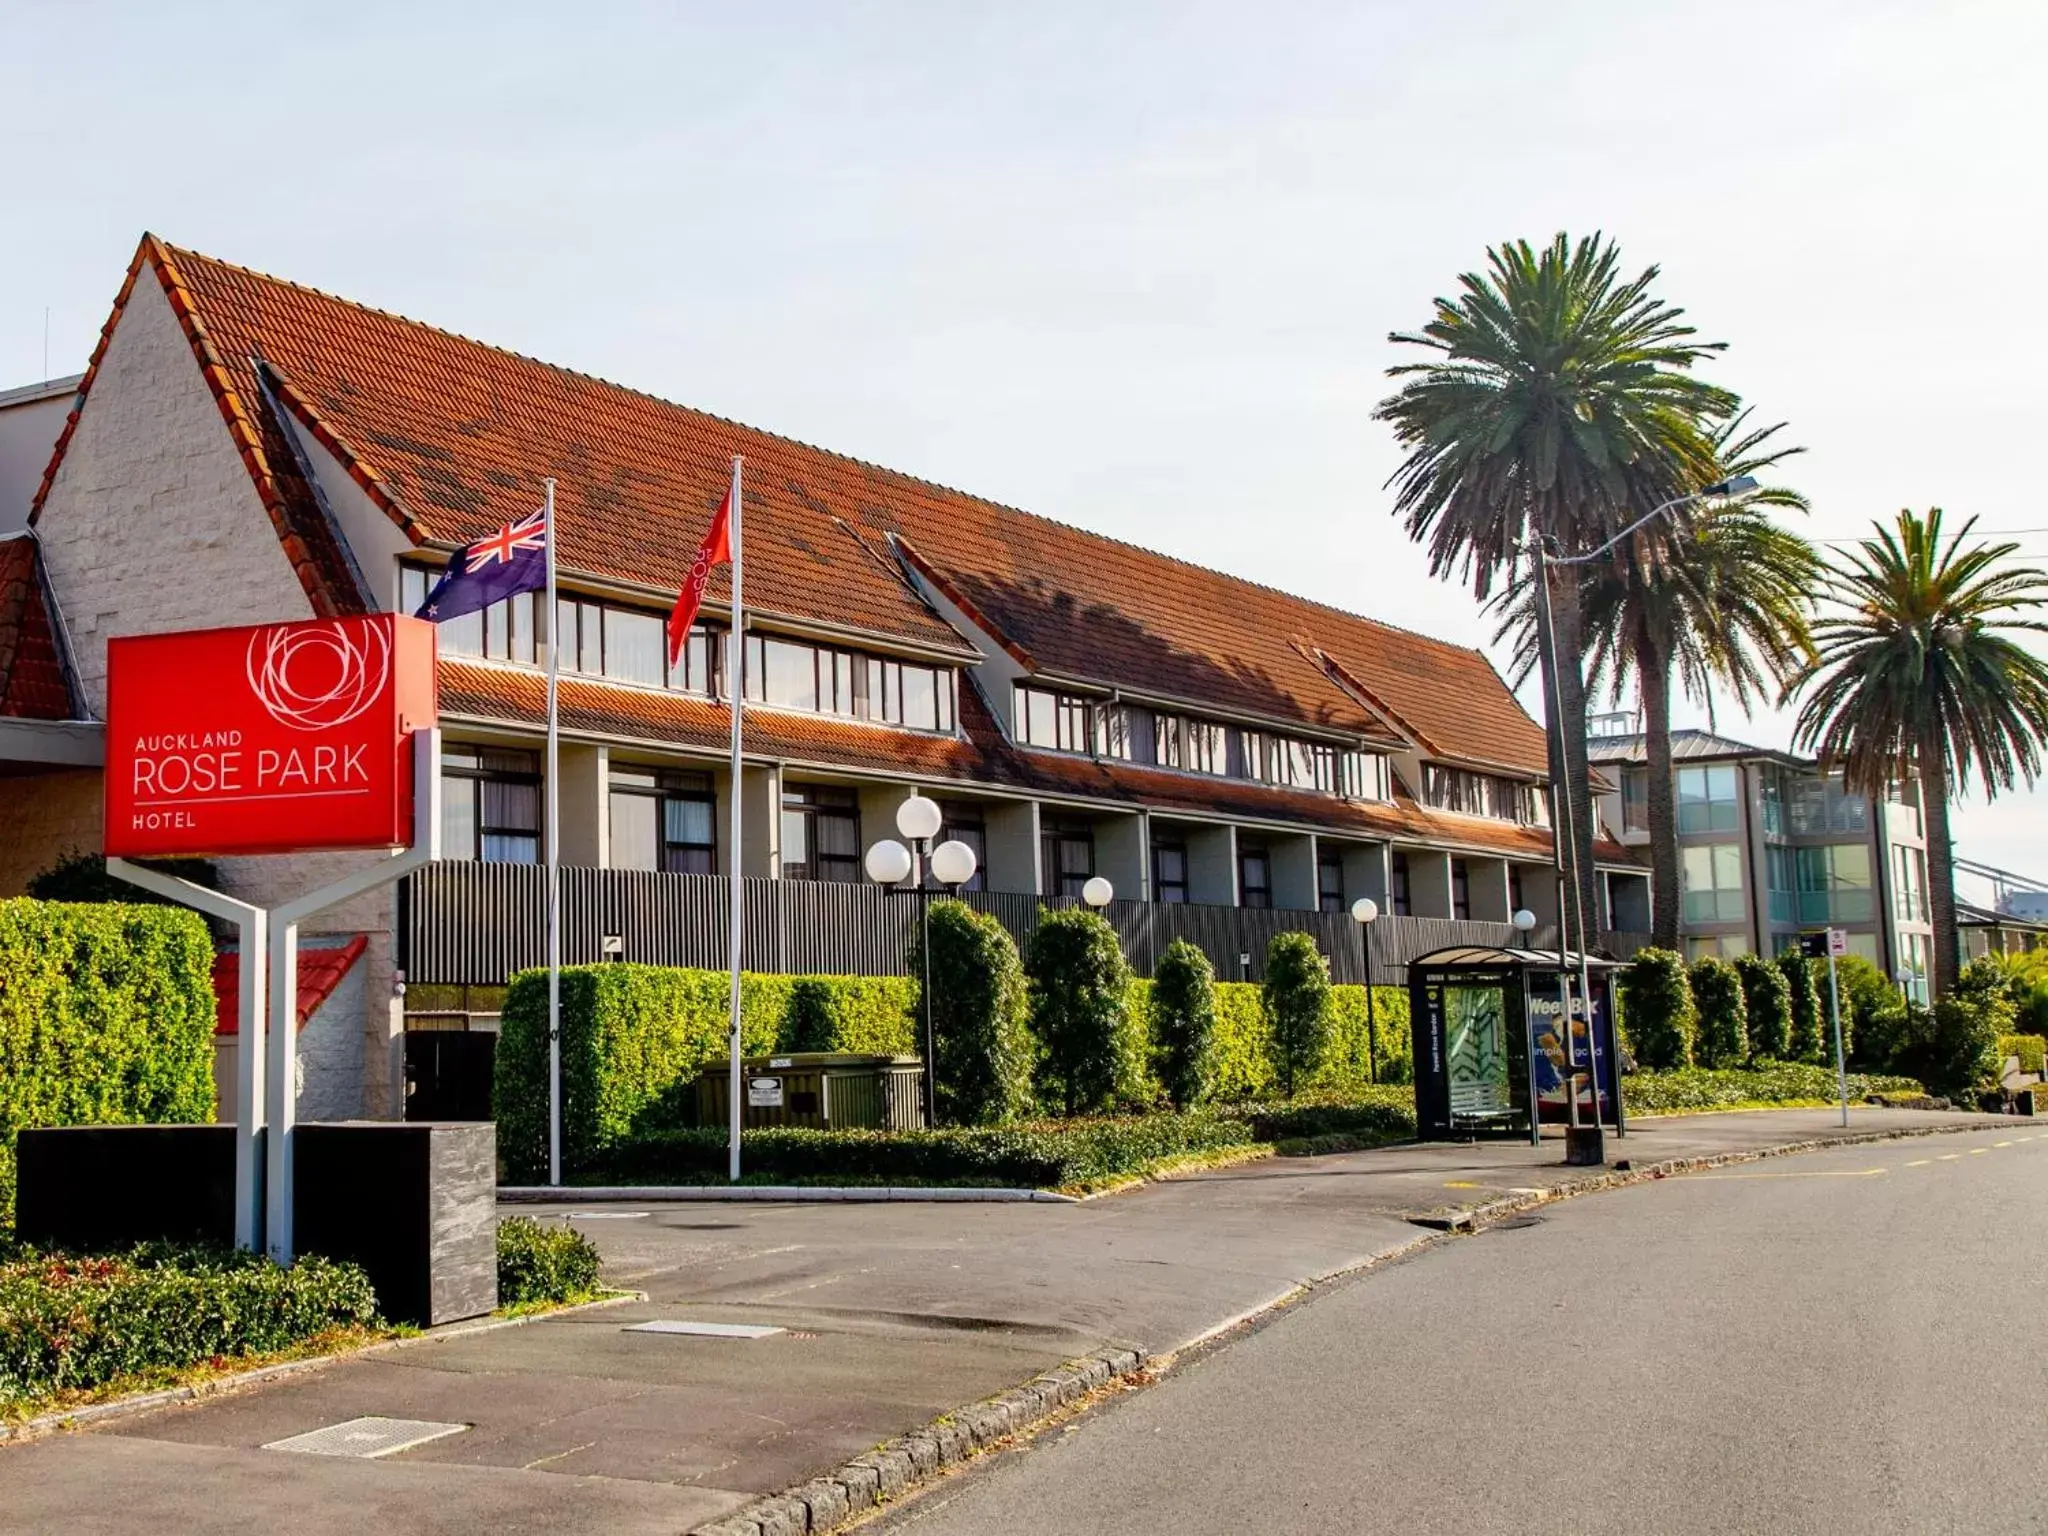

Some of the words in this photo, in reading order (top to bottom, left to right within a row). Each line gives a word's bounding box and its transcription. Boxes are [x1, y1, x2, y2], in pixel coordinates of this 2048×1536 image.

[135, 729, 242, 752] AUCKLAND
[133, 752, 242, 795] ROSE
[257, 743, 369, 787] PARK
[132, 811, 196, 830] HOTEL
